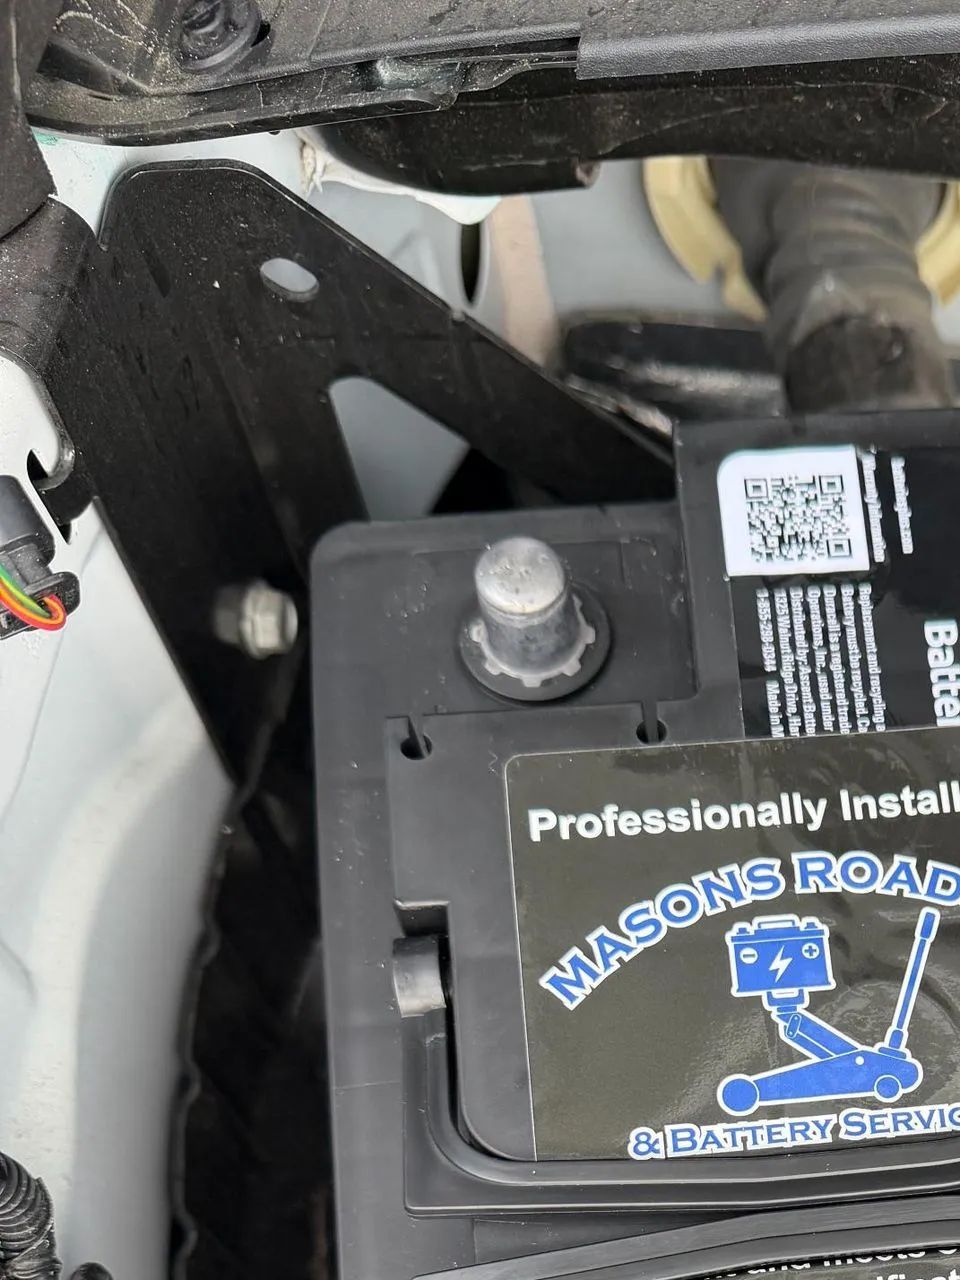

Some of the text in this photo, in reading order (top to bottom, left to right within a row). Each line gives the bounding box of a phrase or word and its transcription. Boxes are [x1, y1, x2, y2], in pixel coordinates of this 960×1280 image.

[789, 587, 809, 650] Distributed
[805, 586, 825, 650] Operations,
[822, 585, 841, 633] Duracell
[840, 584, 856, 630] Battery
[857, 583, 878, 656] Replacement
[776, 613, 793, 656] Walnut
[828, 632, 842, 645] is
[829, 643, 840, 654] a
[845, 627, 862, 658] must
[779, 652, 796, 685] Ridge
[829, 651, 850, 707] registered
[848, 654, 862, 670] be
[866, 652, 882, 675] and
[765, 680, 782, 714] Made
[784, 682, 800, 718] Drive,
[798, 664, 815, 707] Ascent
[817, 674, 833, 701] used
[850, 669, 869, 719] recycled.
[868, 674, 887, 727] recycling
[769, 713, 783, 726] in
[820, 700, 836, 732] under
[528, 793, 827, 841] Professionally
[538, 856, 786, 1011] MASONS
[627, 1126, 665, 1160] &
